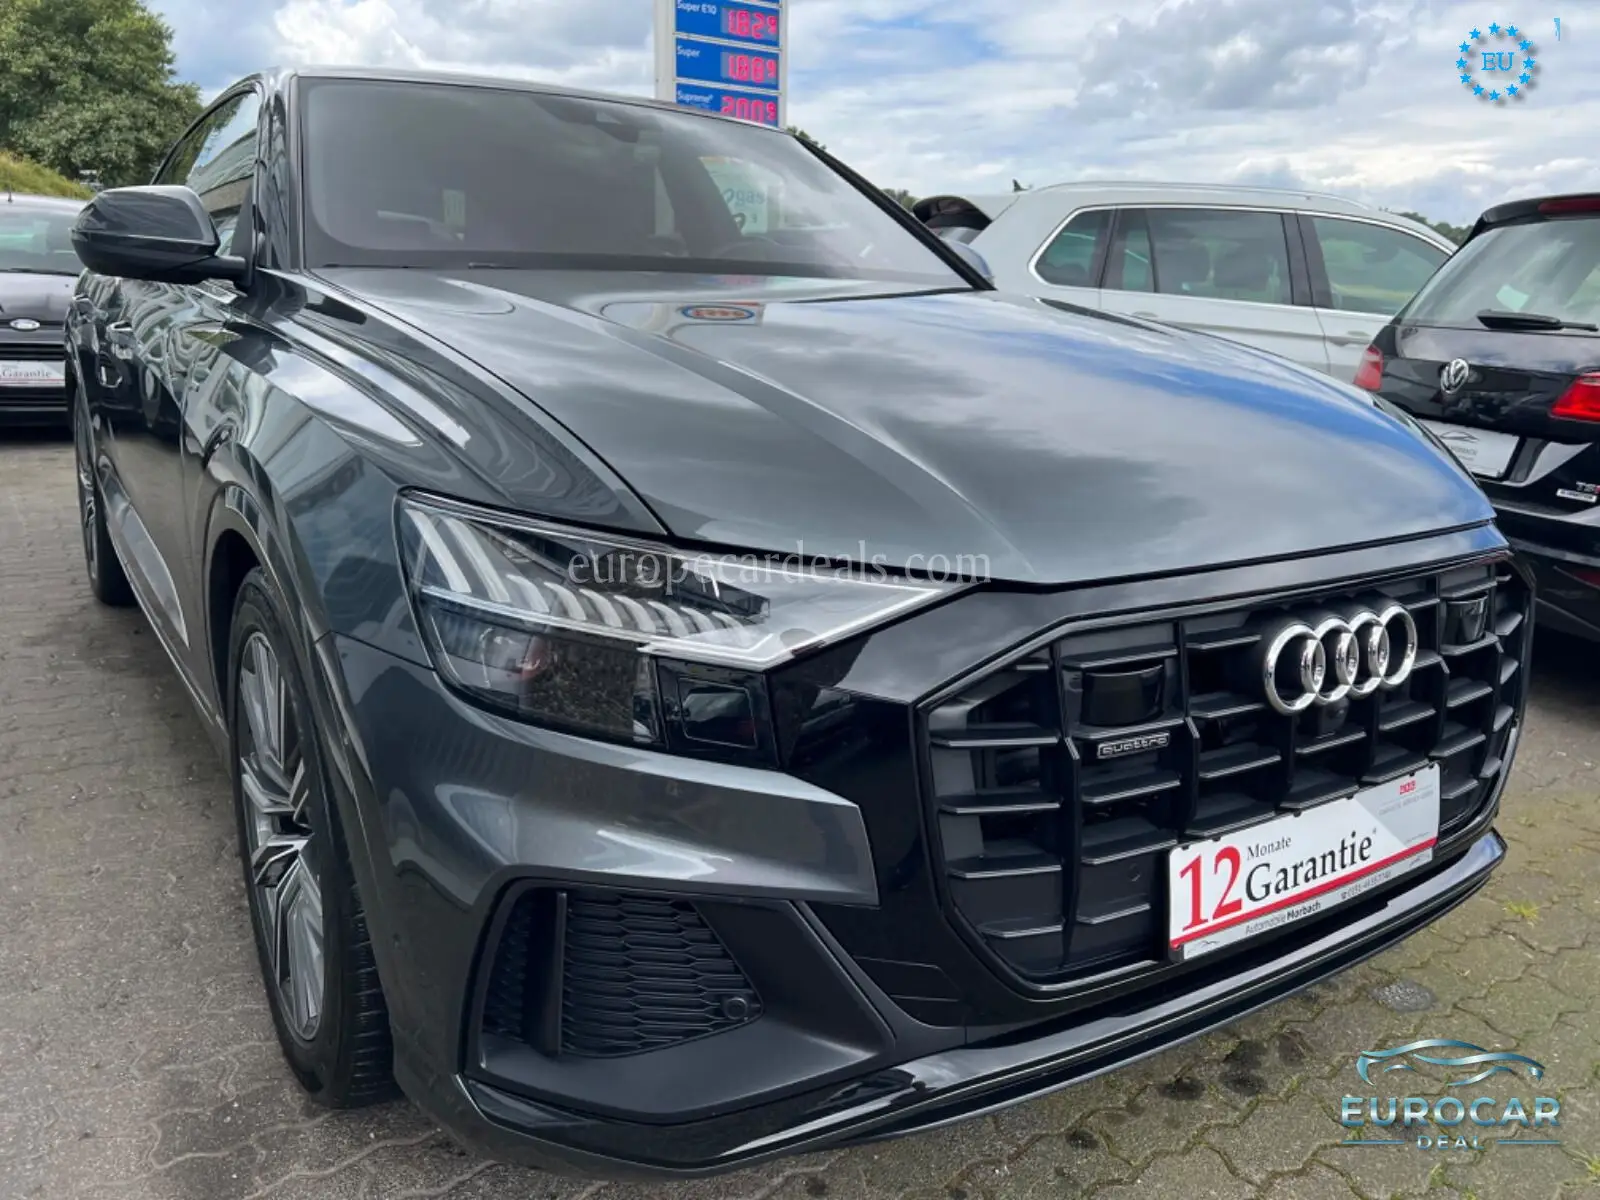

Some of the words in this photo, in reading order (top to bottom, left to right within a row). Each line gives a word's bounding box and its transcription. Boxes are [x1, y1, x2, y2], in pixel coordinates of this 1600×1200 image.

[701, 4, 717, 15] E10
[677, 45, 701, 58] Super
[1102, 737, 1167, 755] quattro
[1246, 836, 1292, 860] Monate
[1180, 846, 1242, 931] 12
